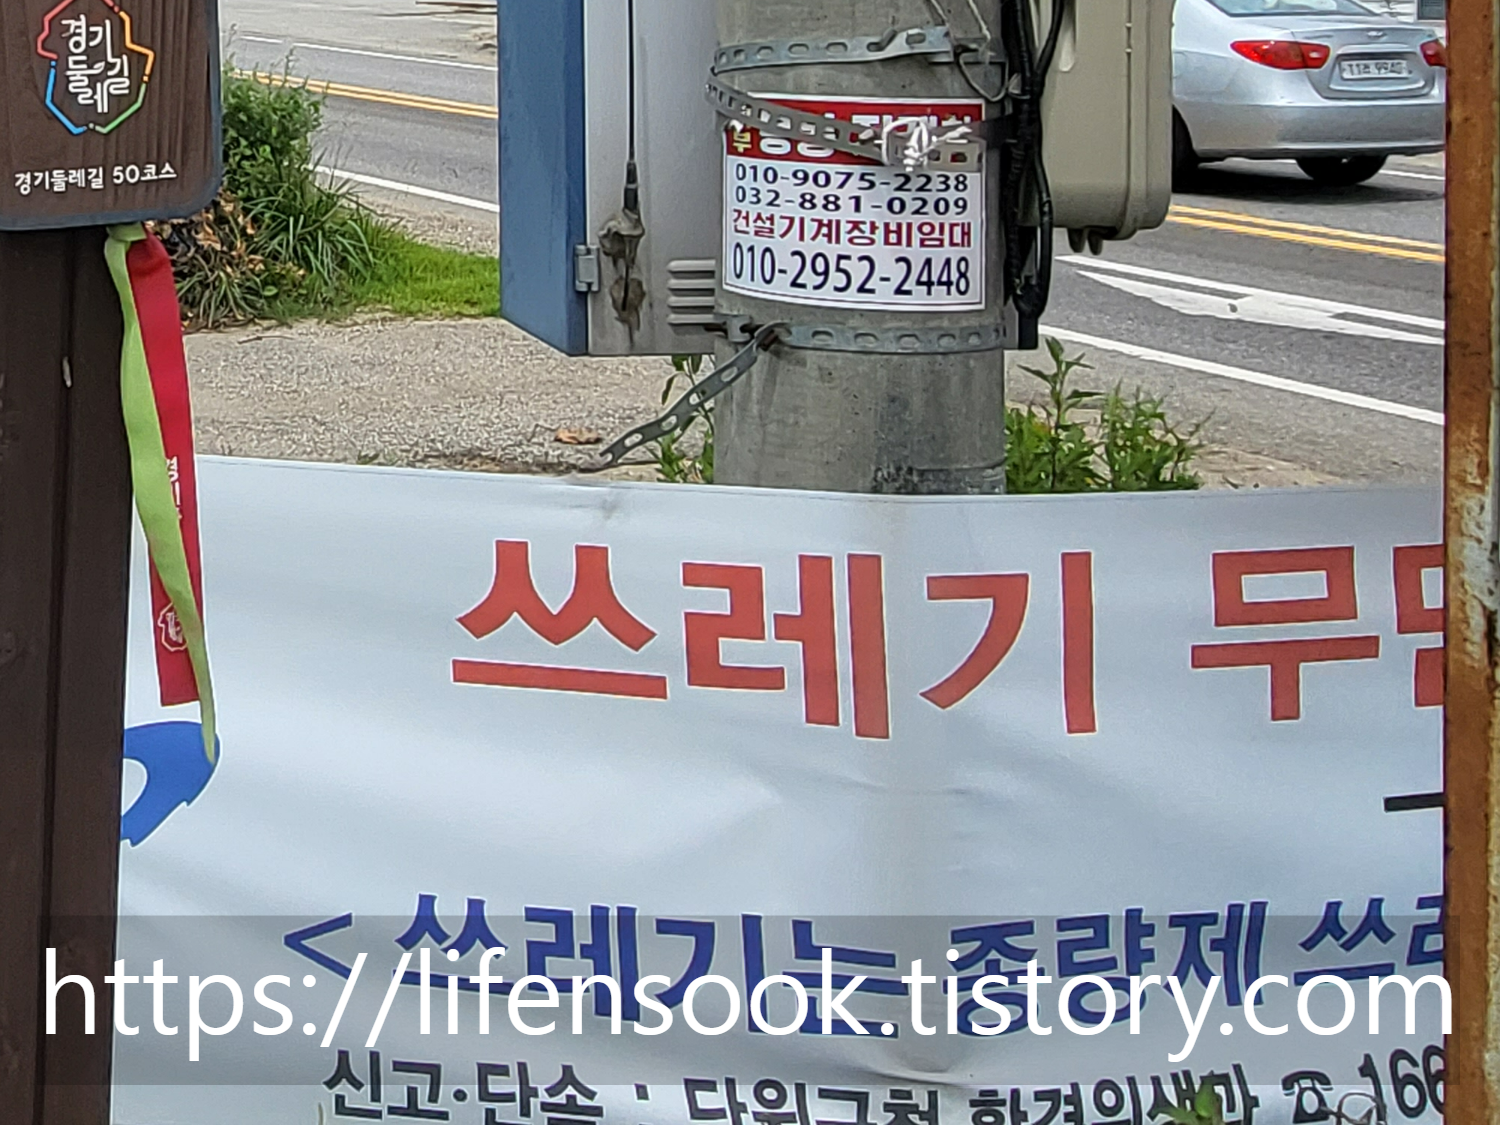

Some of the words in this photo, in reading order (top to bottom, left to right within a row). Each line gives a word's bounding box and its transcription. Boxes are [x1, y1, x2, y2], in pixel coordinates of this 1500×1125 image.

[14, 166, 105, 197] 경기둘레길
[112, 161, 178, 186] 50코스
[735, 163, 969, 193] 010-9075-2238
[735, 185, 969, 217] 032-881-0209
[732, 208, 972, 249] 건설기계장비임대
[732, 241, 970, 297] 010-2952-2448
[451, 538, 1097, 740] 쓰레기
[393, 892, 910, 1039] 쓰레기는
[943, 901, 1269, 1038] 종량제
